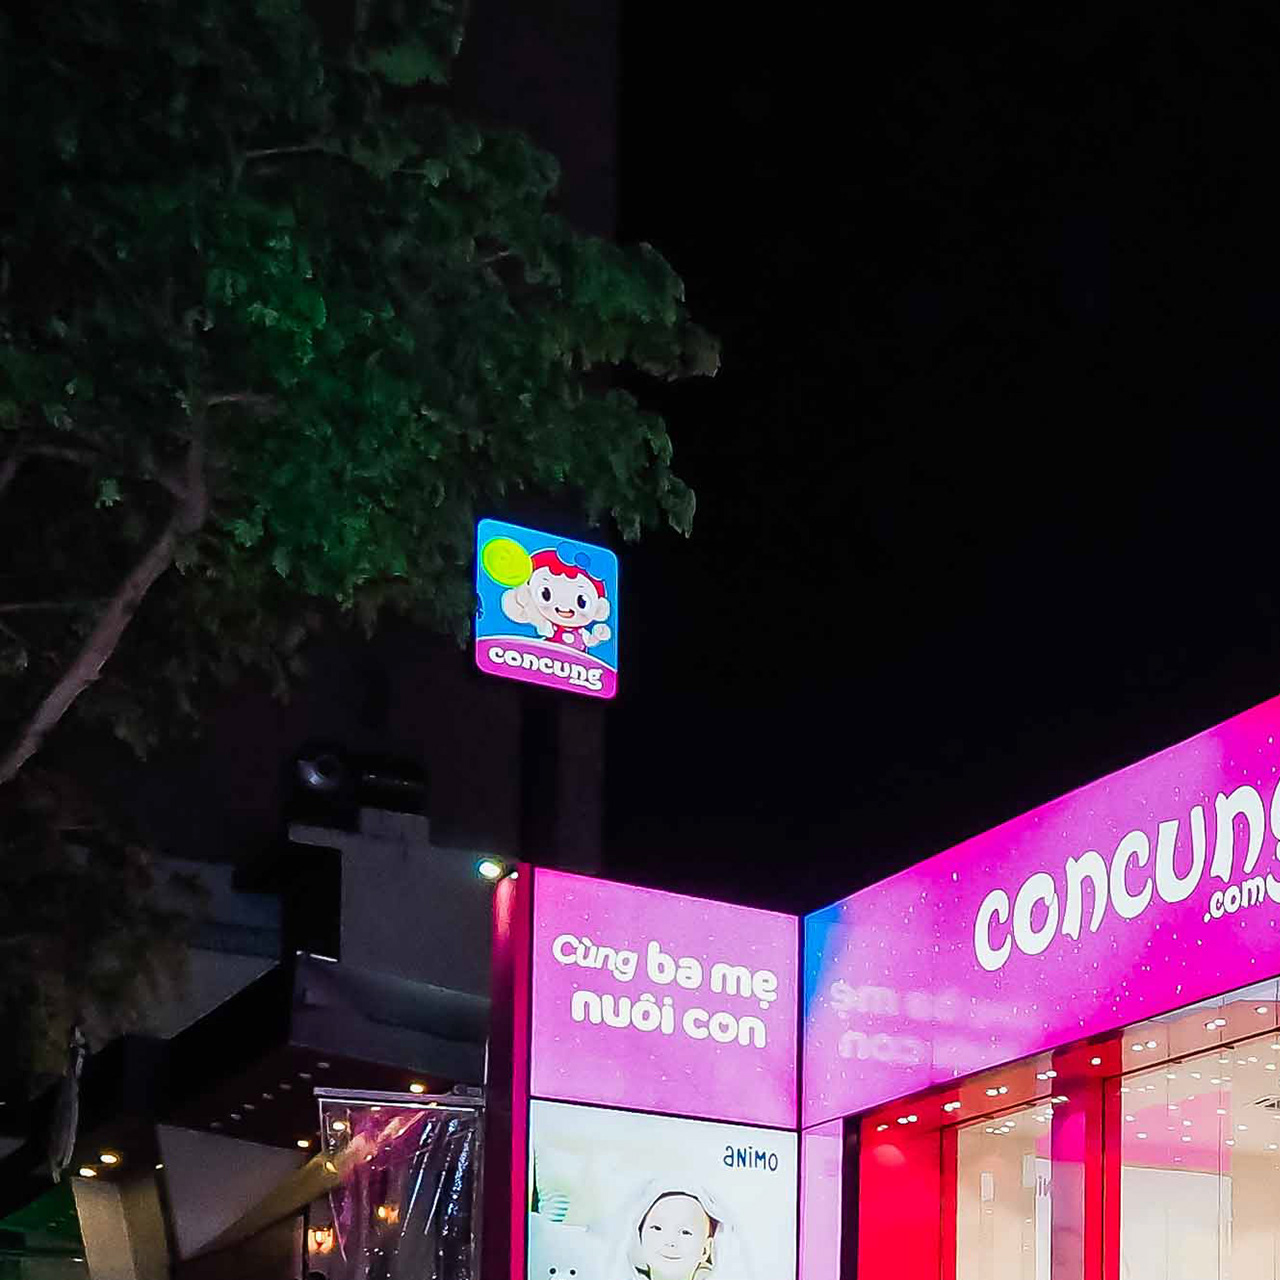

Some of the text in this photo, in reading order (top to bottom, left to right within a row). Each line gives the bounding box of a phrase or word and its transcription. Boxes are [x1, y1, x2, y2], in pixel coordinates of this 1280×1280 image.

[487, 645, 604, 692] concung
[1203, 876, 1266, 923] .com
[551, 933, 779, 1010] Cùng ba mẹ
[571, 983, 768, 1050] nuôi con
